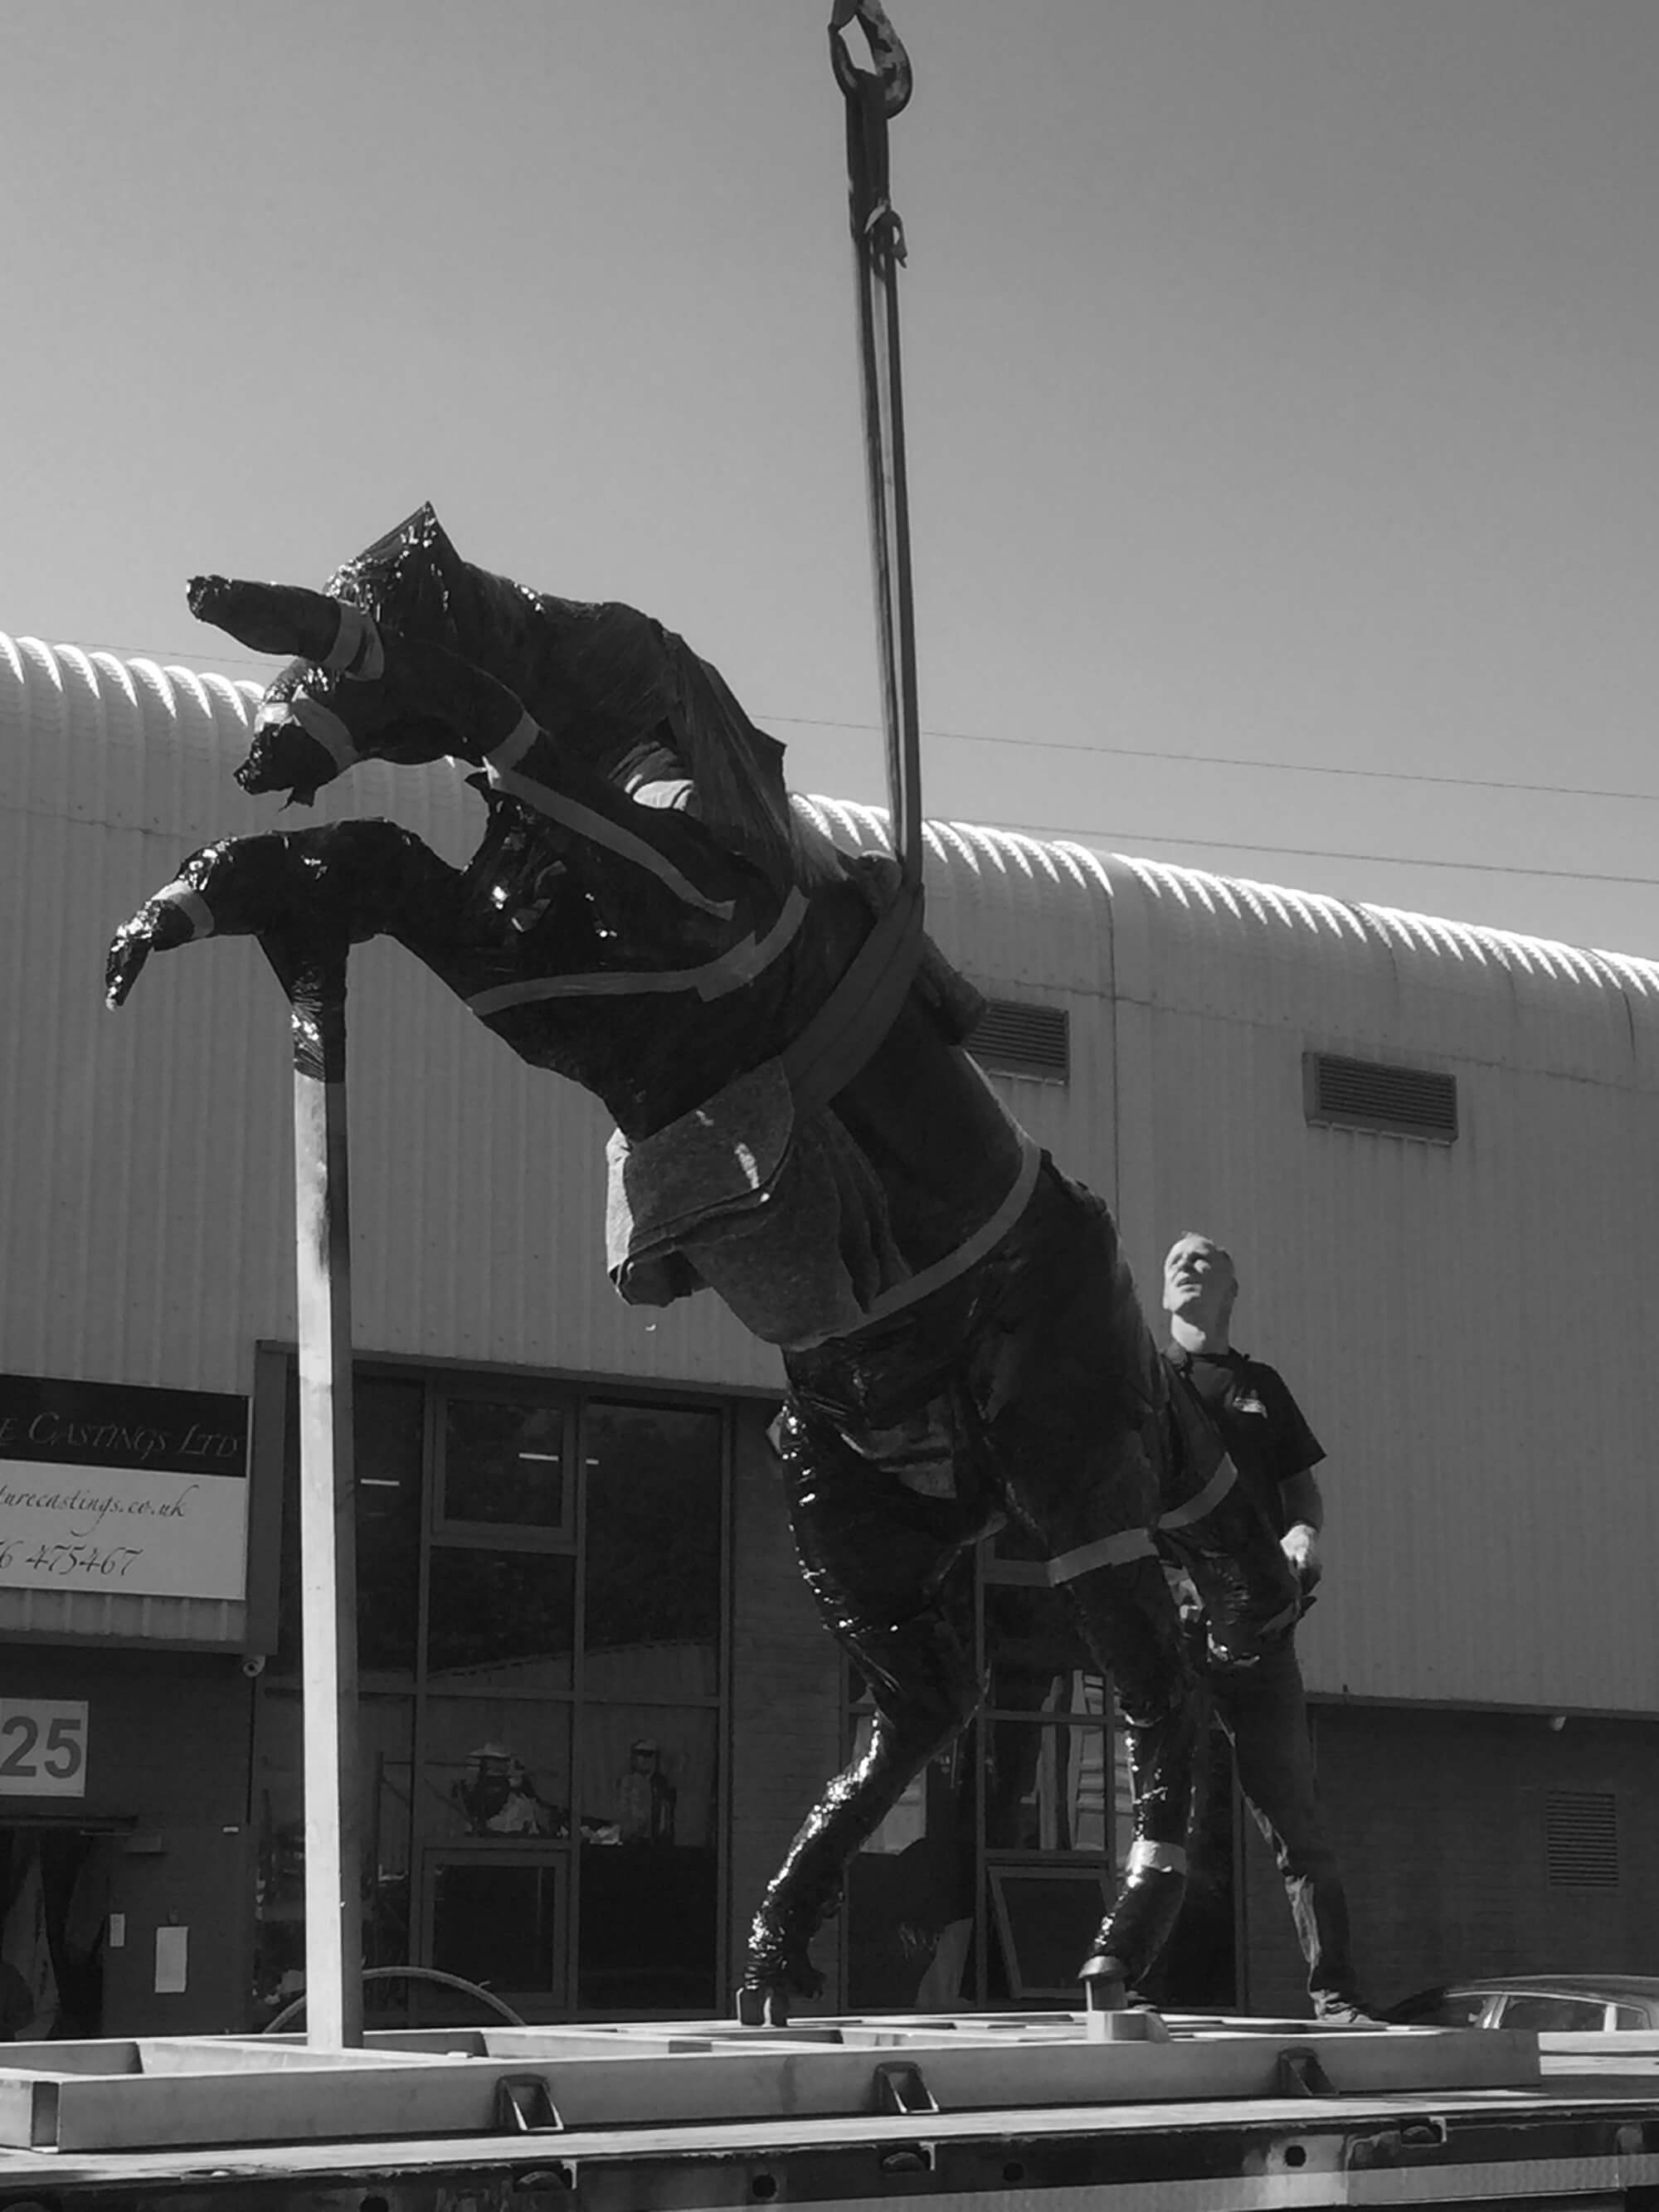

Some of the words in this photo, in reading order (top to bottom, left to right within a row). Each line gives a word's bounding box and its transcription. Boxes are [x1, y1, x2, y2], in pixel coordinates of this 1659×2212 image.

[28, 1412, 167, 1461] CASTINGS
[179, 1423, 239, 1457] LTD
[26, 1544, 144, 1576] 475467
[0, 1716, 81, 1779] 25
